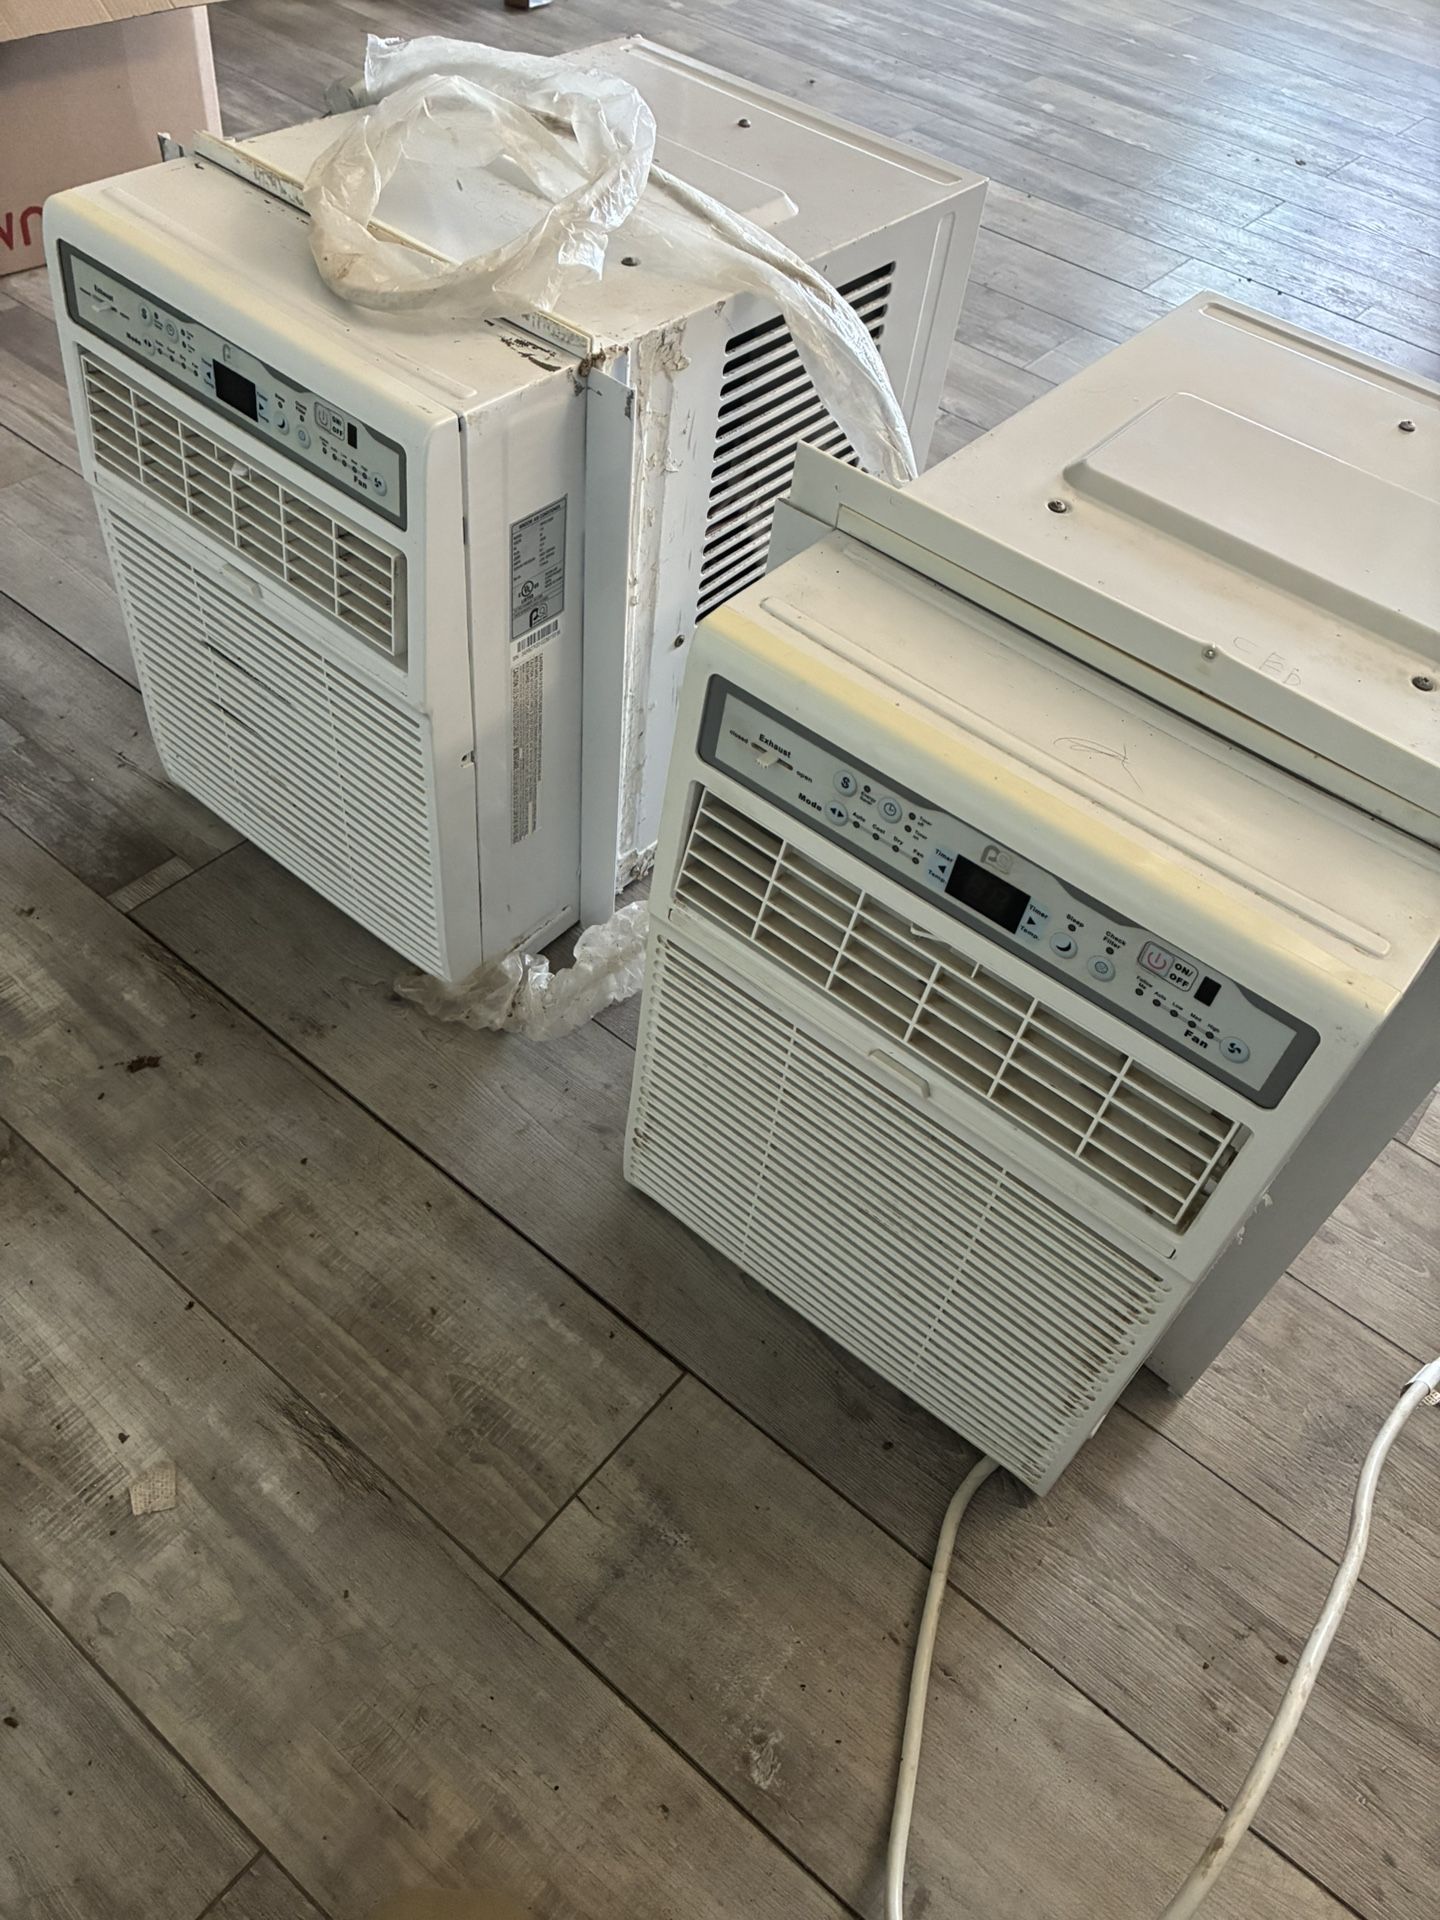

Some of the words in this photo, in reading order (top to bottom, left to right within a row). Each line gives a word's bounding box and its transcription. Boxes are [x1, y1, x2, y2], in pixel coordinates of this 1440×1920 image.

[759, 733, 792, 759] Exhaust
[796, 770, 813, 784] open
[798, 792, 823, 812] Mode
[872, 823, 887, 835] Cool
[893, 835, 904, 846] Dry
[935, 848, 954, 863] Timer
[1029, 903, 1049, 920] Timer
[1066, 913, 1085, 928] Sleep
[1102, 935, 1121, 950] Filter
[1105, 930, 1127, 947] Check
[1174, 963, 1194, 978] ON/
[1169, 973, 1190, 988] OFF
[1184, 1029, 1208, 1049] Fan
